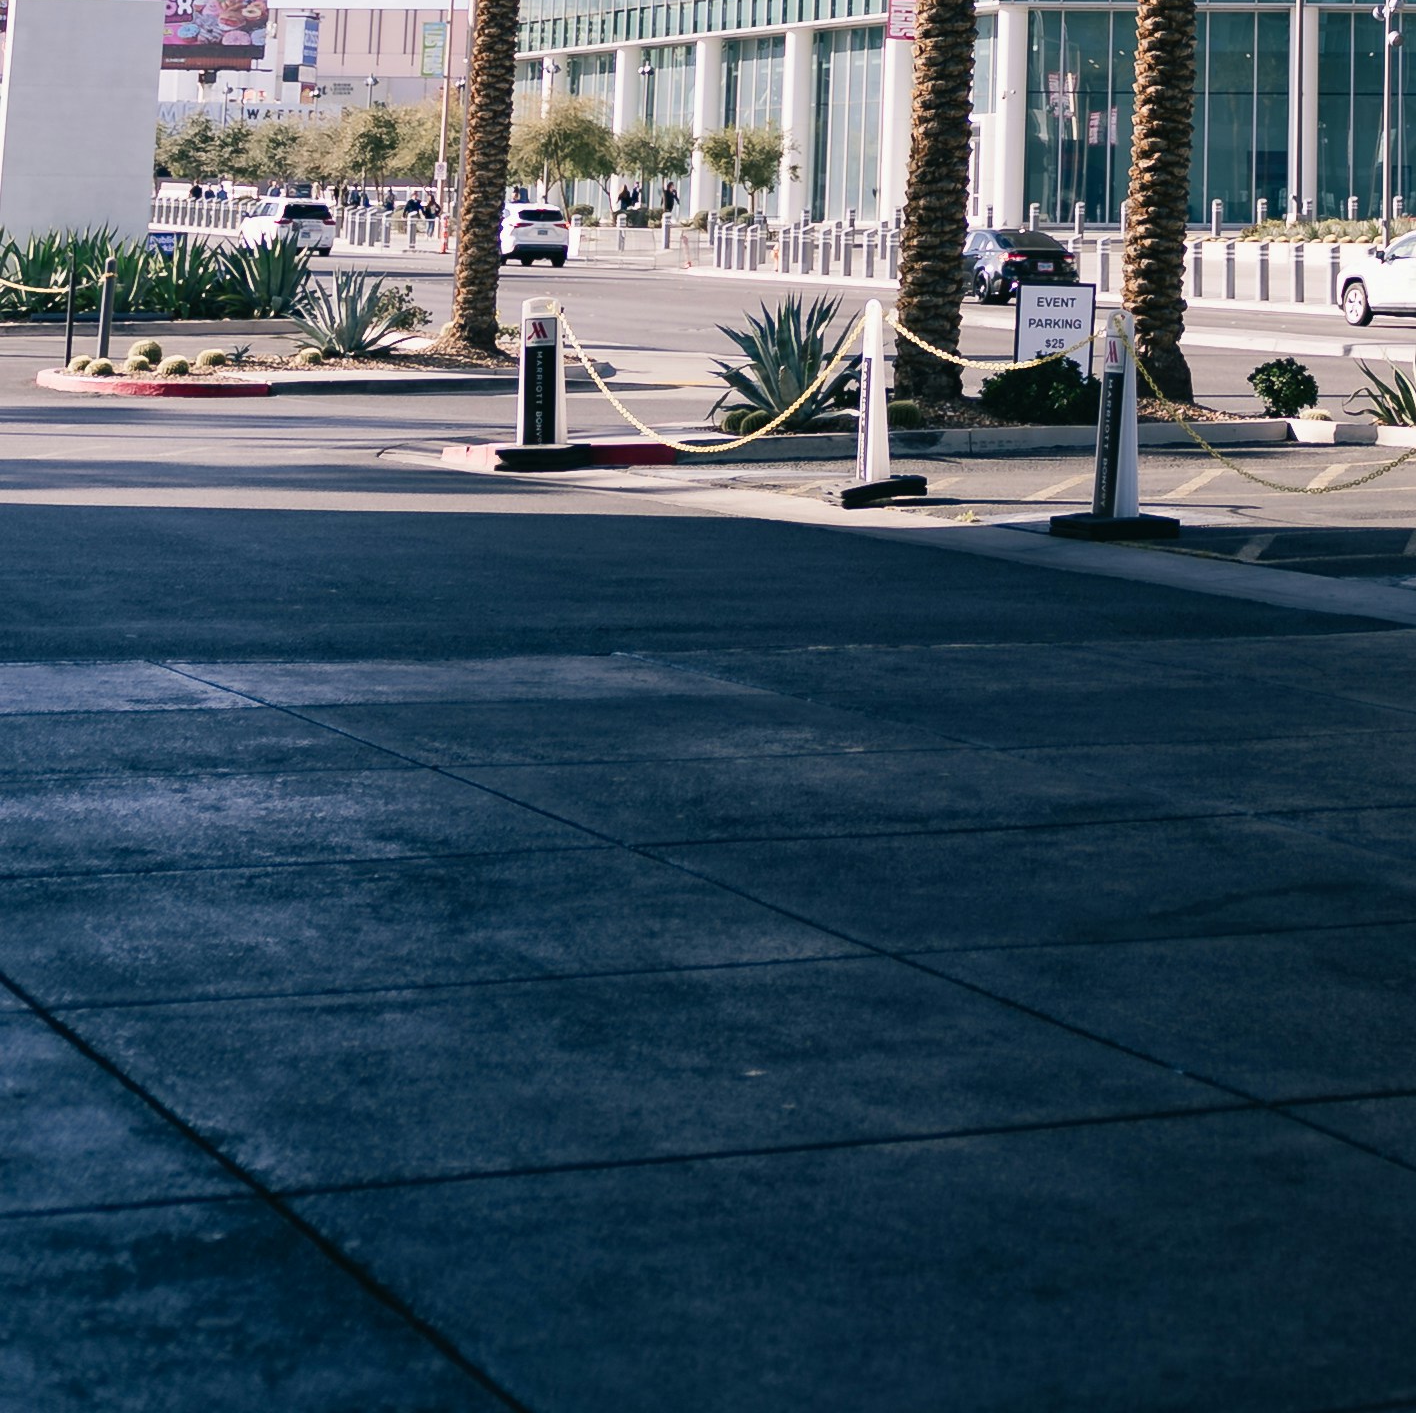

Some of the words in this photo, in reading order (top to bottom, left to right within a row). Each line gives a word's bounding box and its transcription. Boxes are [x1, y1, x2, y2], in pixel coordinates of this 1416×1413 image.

[890, 0, 917, 37] VEGAS
[1036, 296, 1077, 308] EVENT
[1028, 318, 1082, 330] PARKING
[1045, 338, 1065, 349] $25
[1104, 378, 1114, 450] MARRIOTT
